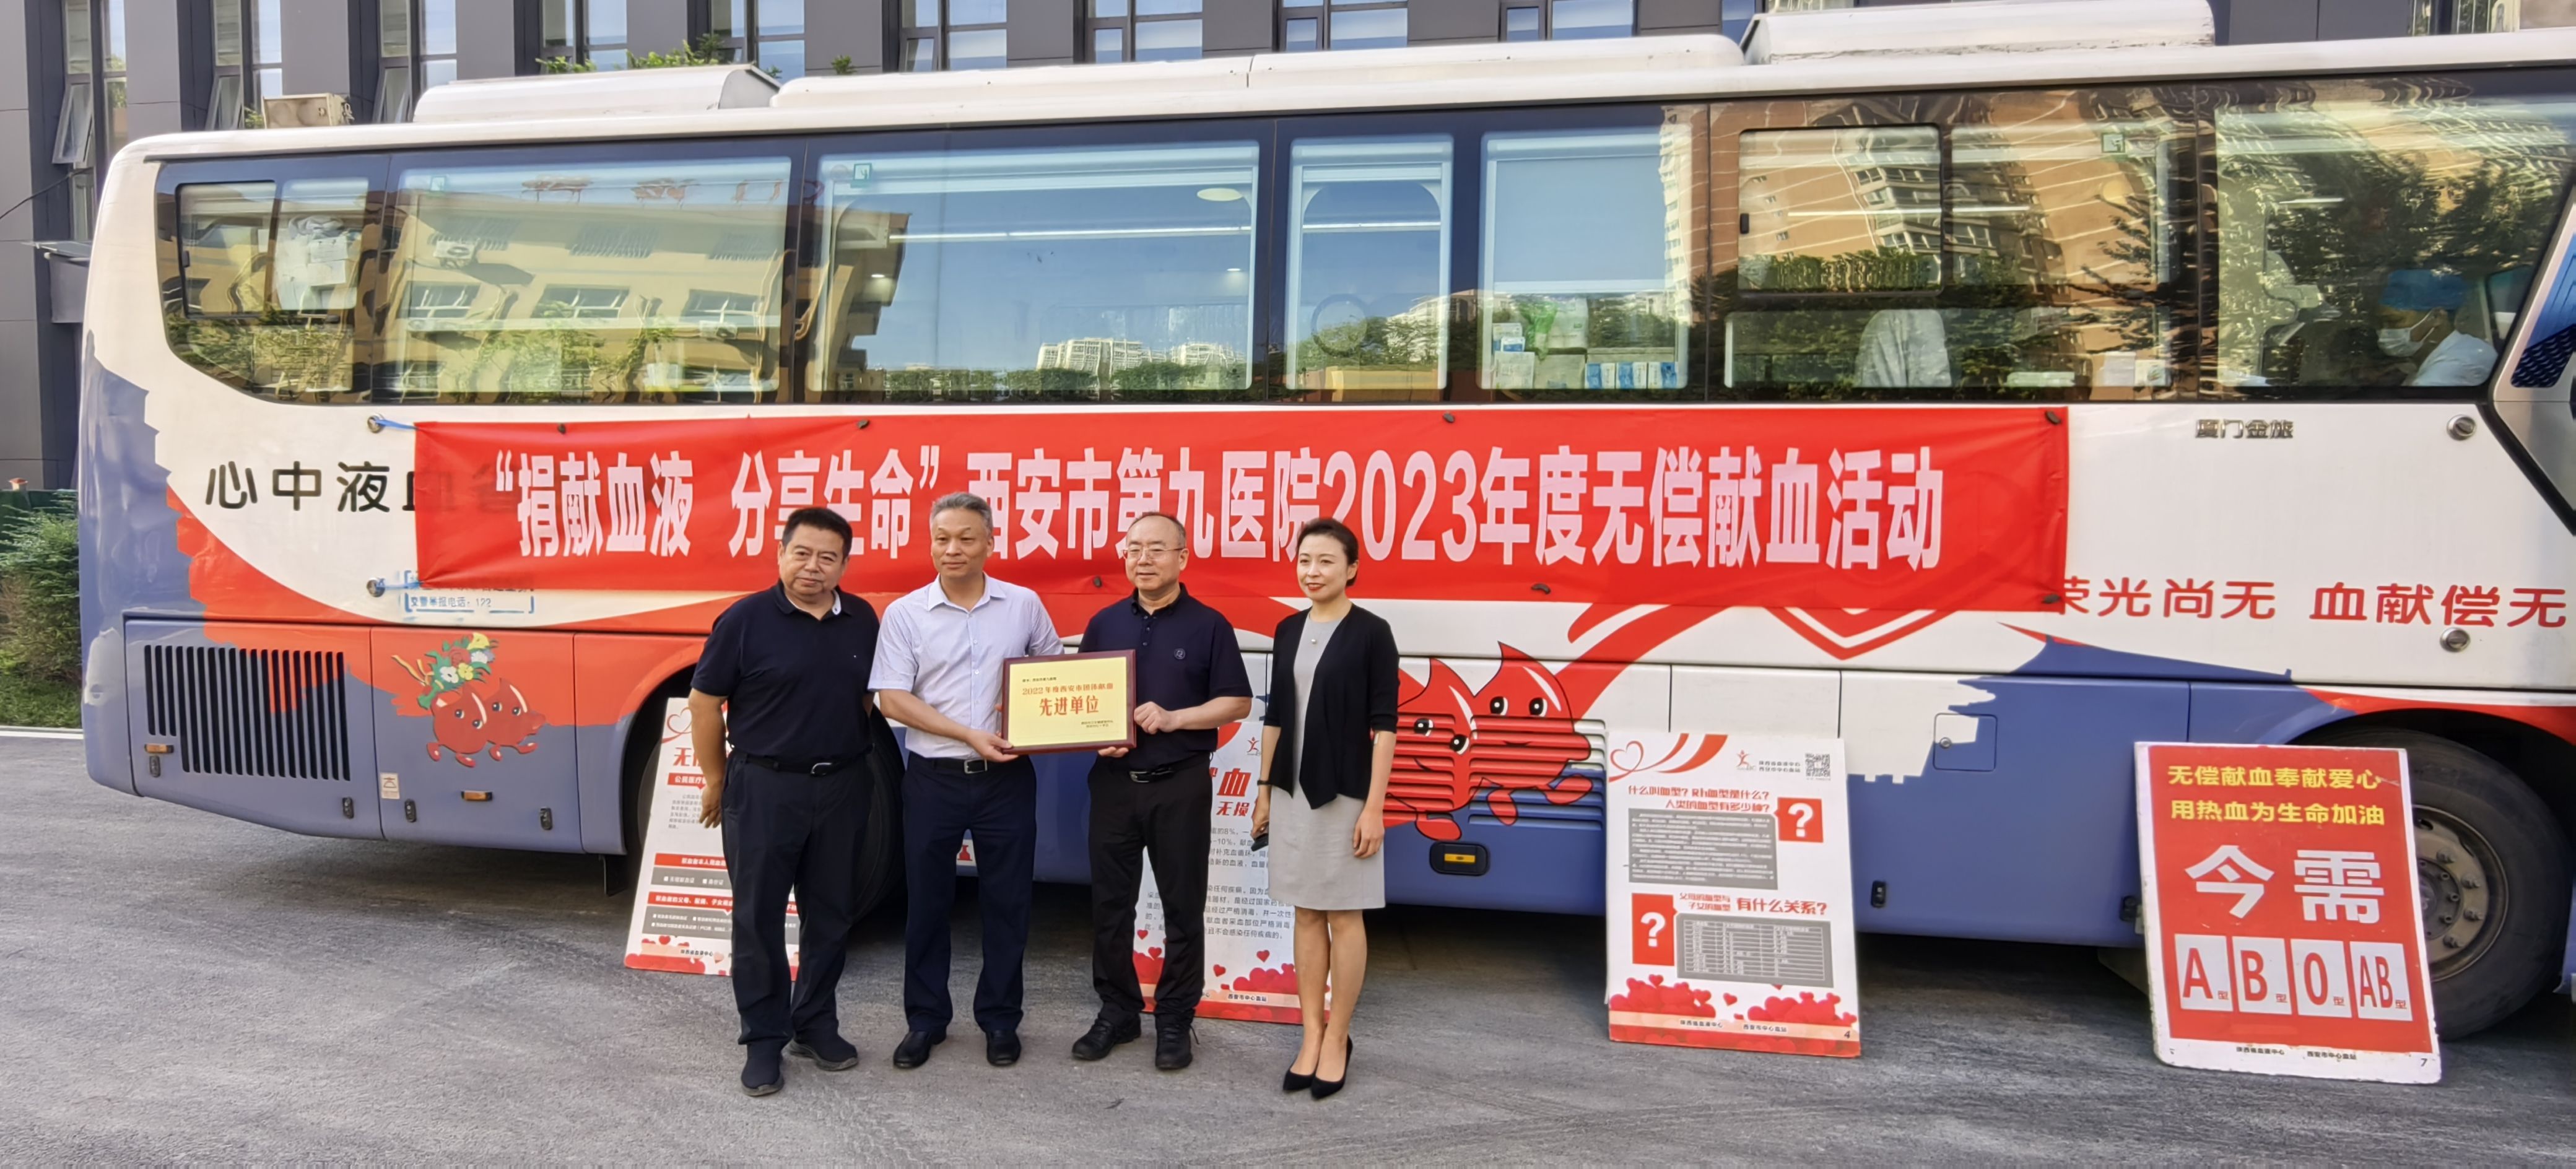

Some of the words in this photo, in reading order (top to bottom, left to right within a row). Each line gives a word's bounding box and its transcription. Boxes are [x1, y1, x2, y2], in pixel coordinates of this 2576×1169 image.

[495, 448, 694, 557] “捐献血液
[728, 445, 941, 560] 分享生命”
[1039, 695, 1099, 717] 先进单位
[2167, 765, 2382, 789] 无偿献血奉献爱心
[2171, 800, 2385, 825] 用热血为生命加油
[2185, 845, 2385, 924] 今需
[1736, 897, 1827, 916] 有什么关系？
[1843, 1031, 1850, 1039] 4
[2420, 1058, 2428, 1067] 7
